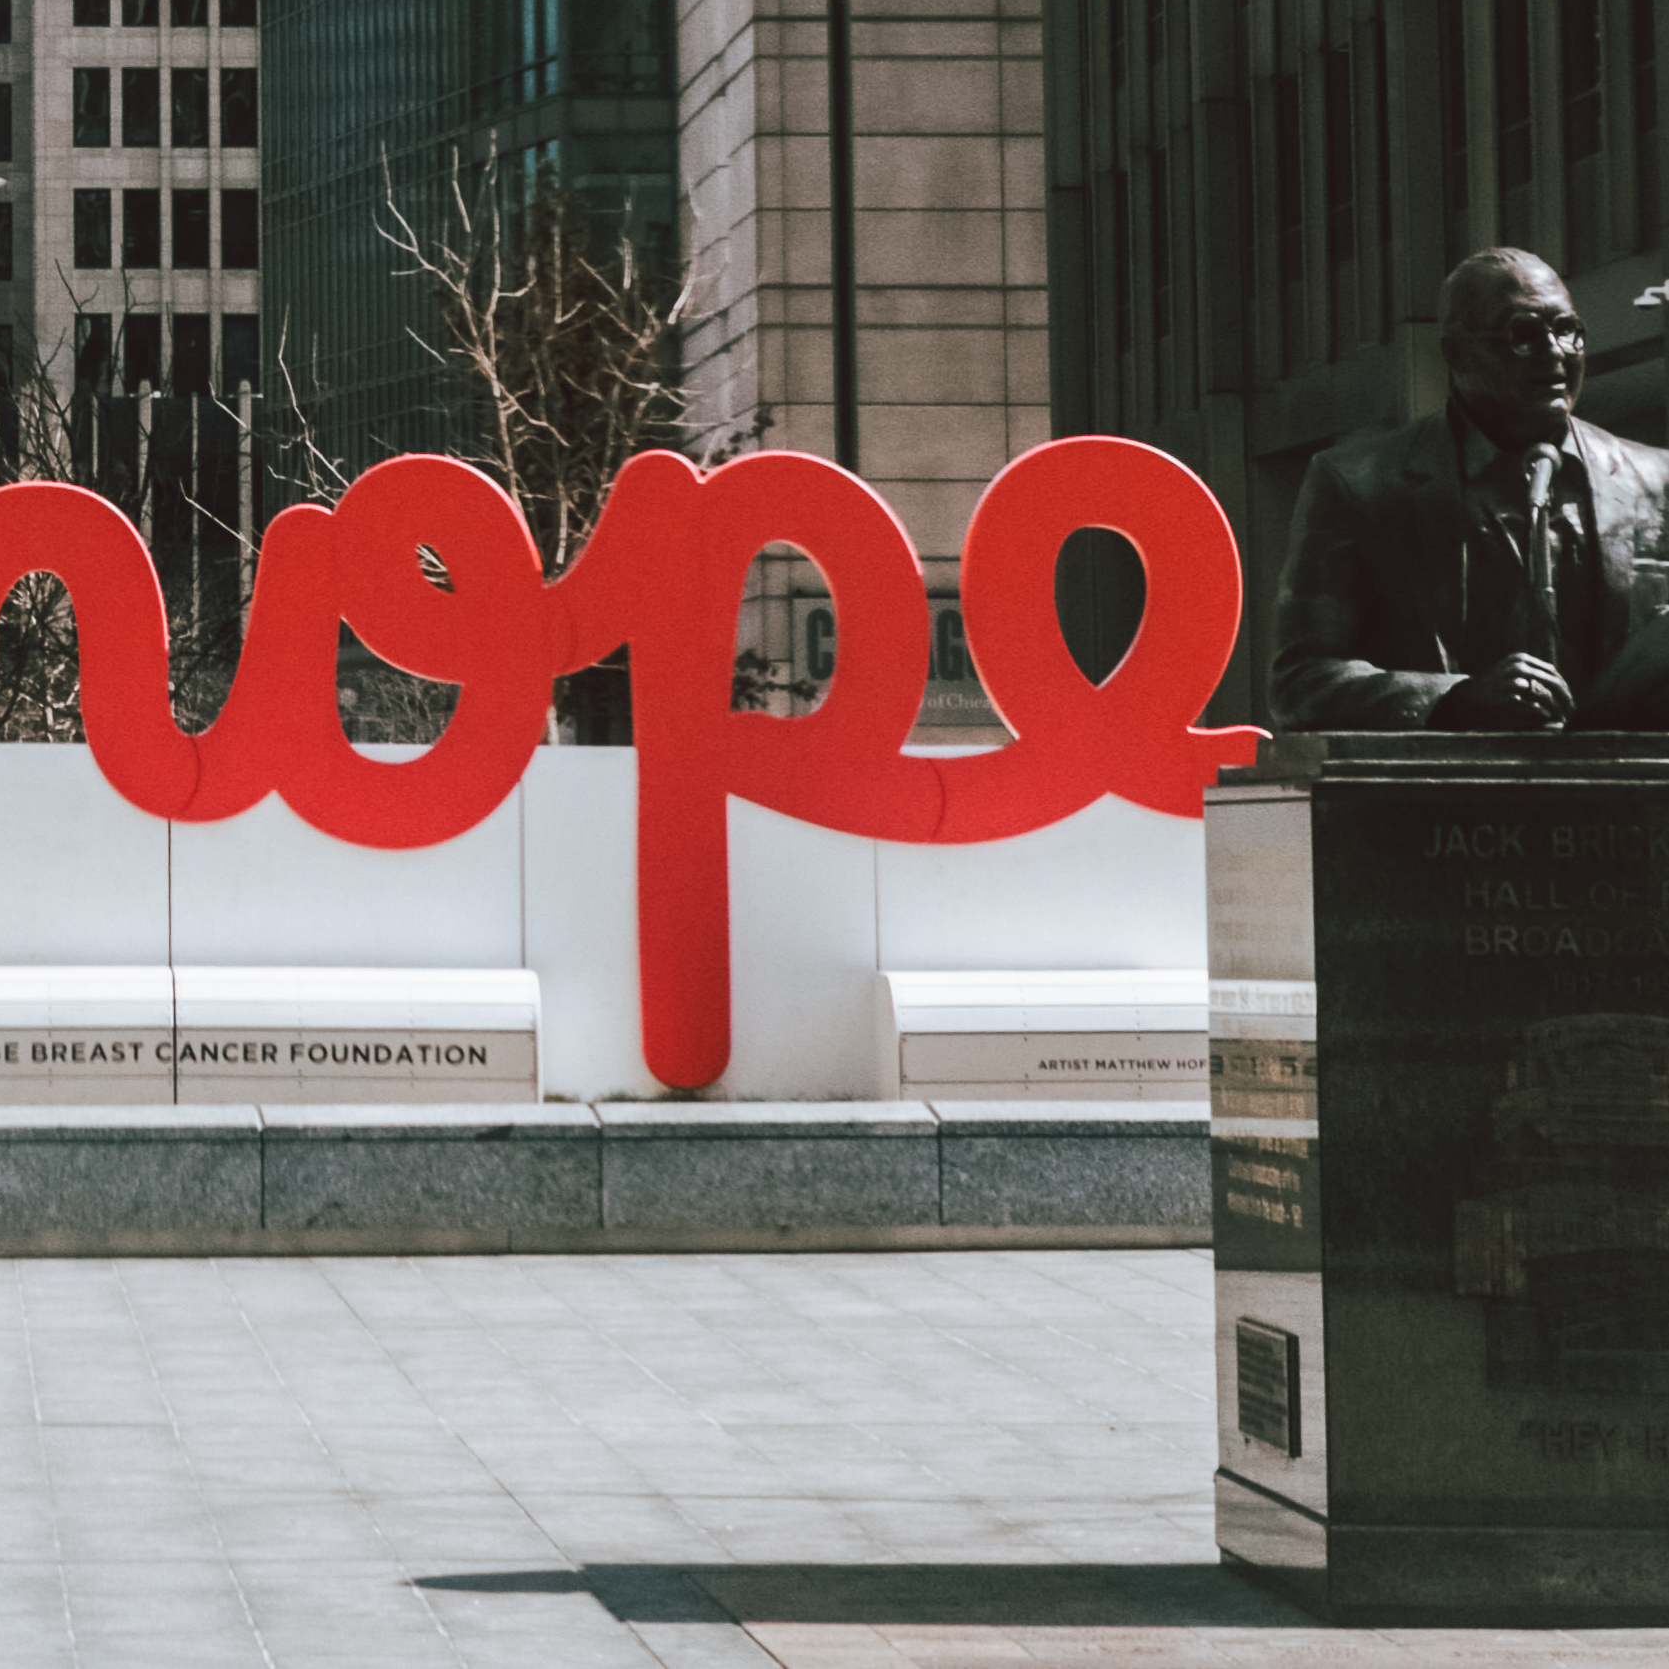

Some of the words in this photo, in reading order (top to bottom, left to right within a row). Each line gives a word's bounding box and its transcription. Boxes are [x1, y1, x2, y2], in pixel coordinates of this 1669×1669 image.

[1423, 823, 1526, 859] JACK
[31, 1042, 144, 1064] BREAST
[155, 1042, 278, 1064] CANCER
[289, 1042, 488, 1065] FOUNDATION
[1038, 1058, 1089, 1071] ARTIST
[1095, 1058, 1171, 1071] MATTHEW
